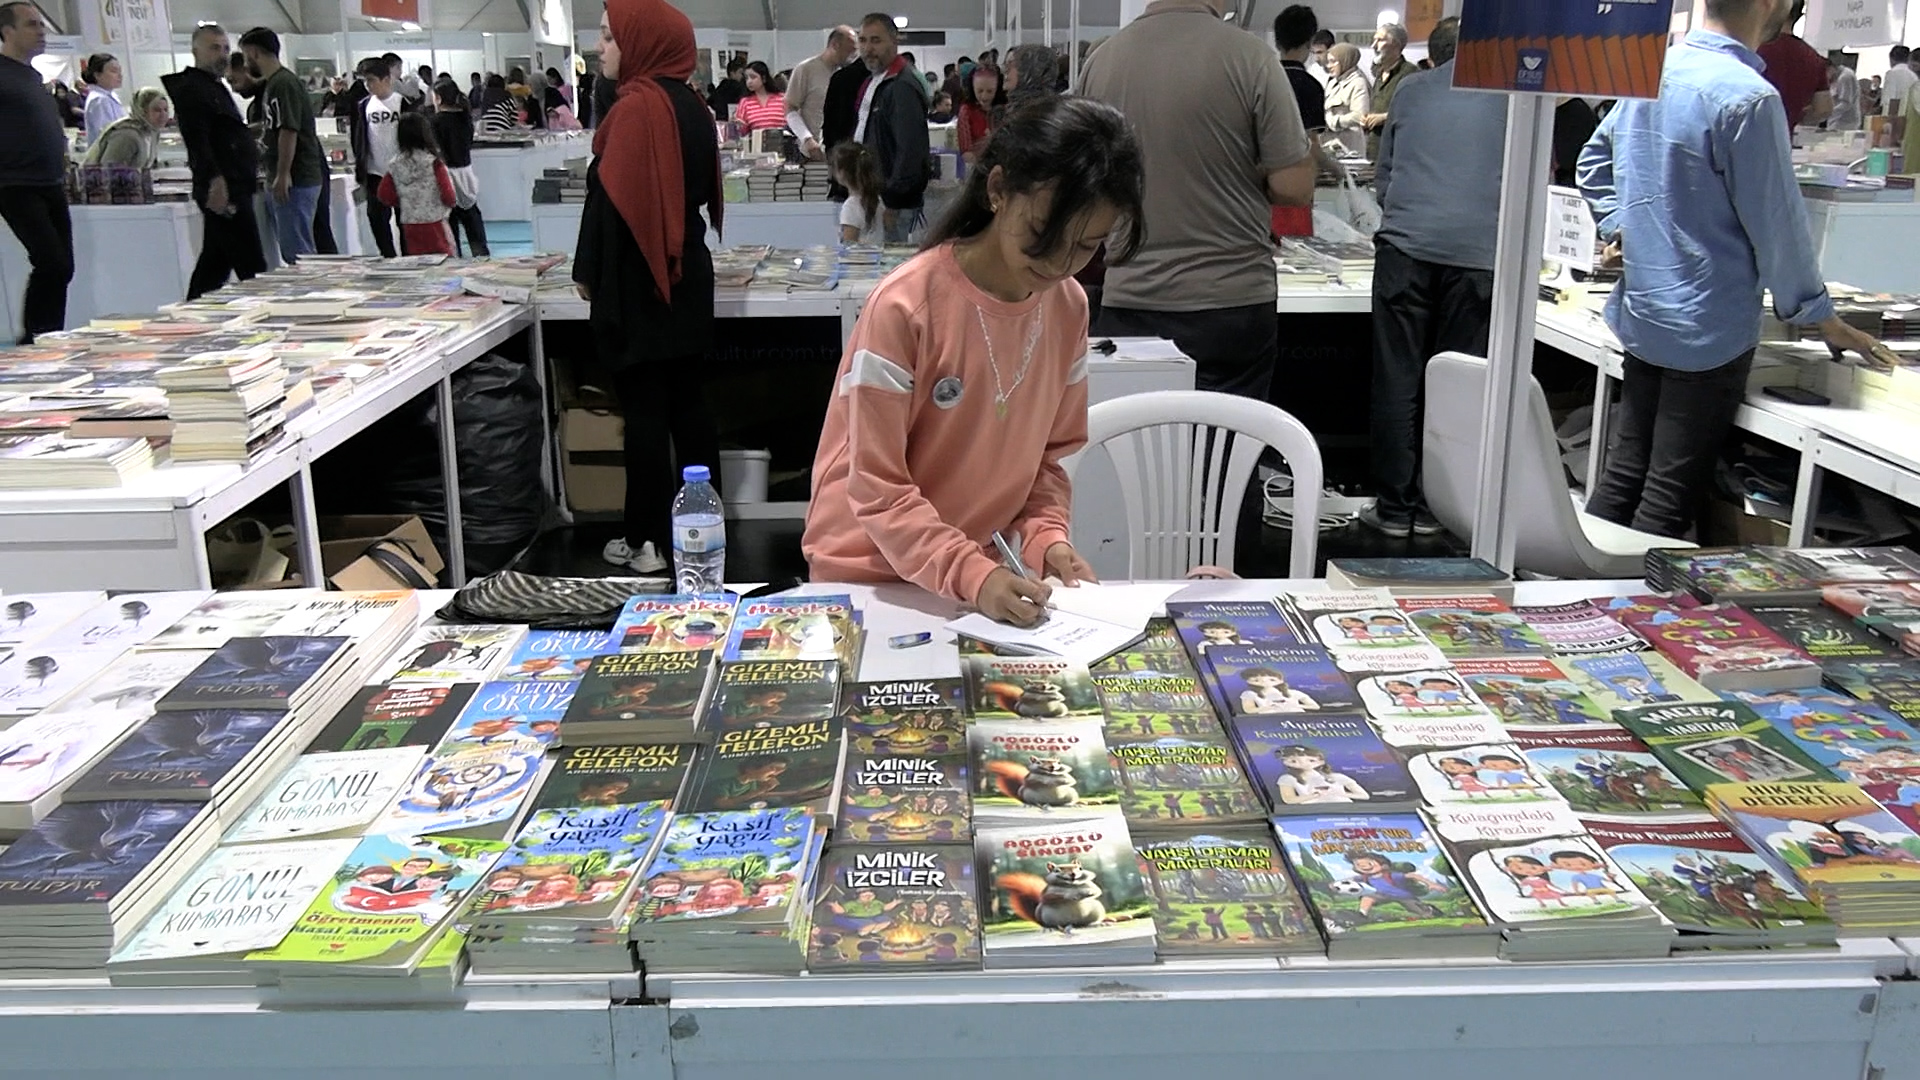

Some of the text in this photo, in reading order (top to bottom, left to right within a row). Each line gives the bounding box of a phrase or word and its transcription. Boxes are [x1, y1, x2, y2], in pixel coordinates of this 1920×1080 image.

[595, 660, 699, 674] TELEFON
[723, 670, 825, 683] TELEFON
[505, 682, 572, 695] ALTIN
[869, 682, 935, 695] MİNİK
[1640, 706, 1737, 725] MACERA
[716, 732, 830, 754] TELEFON
[1165, 747, 1227, 757] ORMAN
[563, 755, 680, 770] TELEFON
[865, 758, 939, 772] MİNİK
[1125, 755, 1226, 766] MACERALARI
[259, 800, 369, 823] KUMBARASI
[856, 851, 939, 869] MİNİK
[1200, 847, 1272, 859] ORMAN
[1156, 857, 1272, 871] MACERALARI
[846, 869, 946, 888] İZCİLER
[160, 903, 288, 935] KUMBARASI
